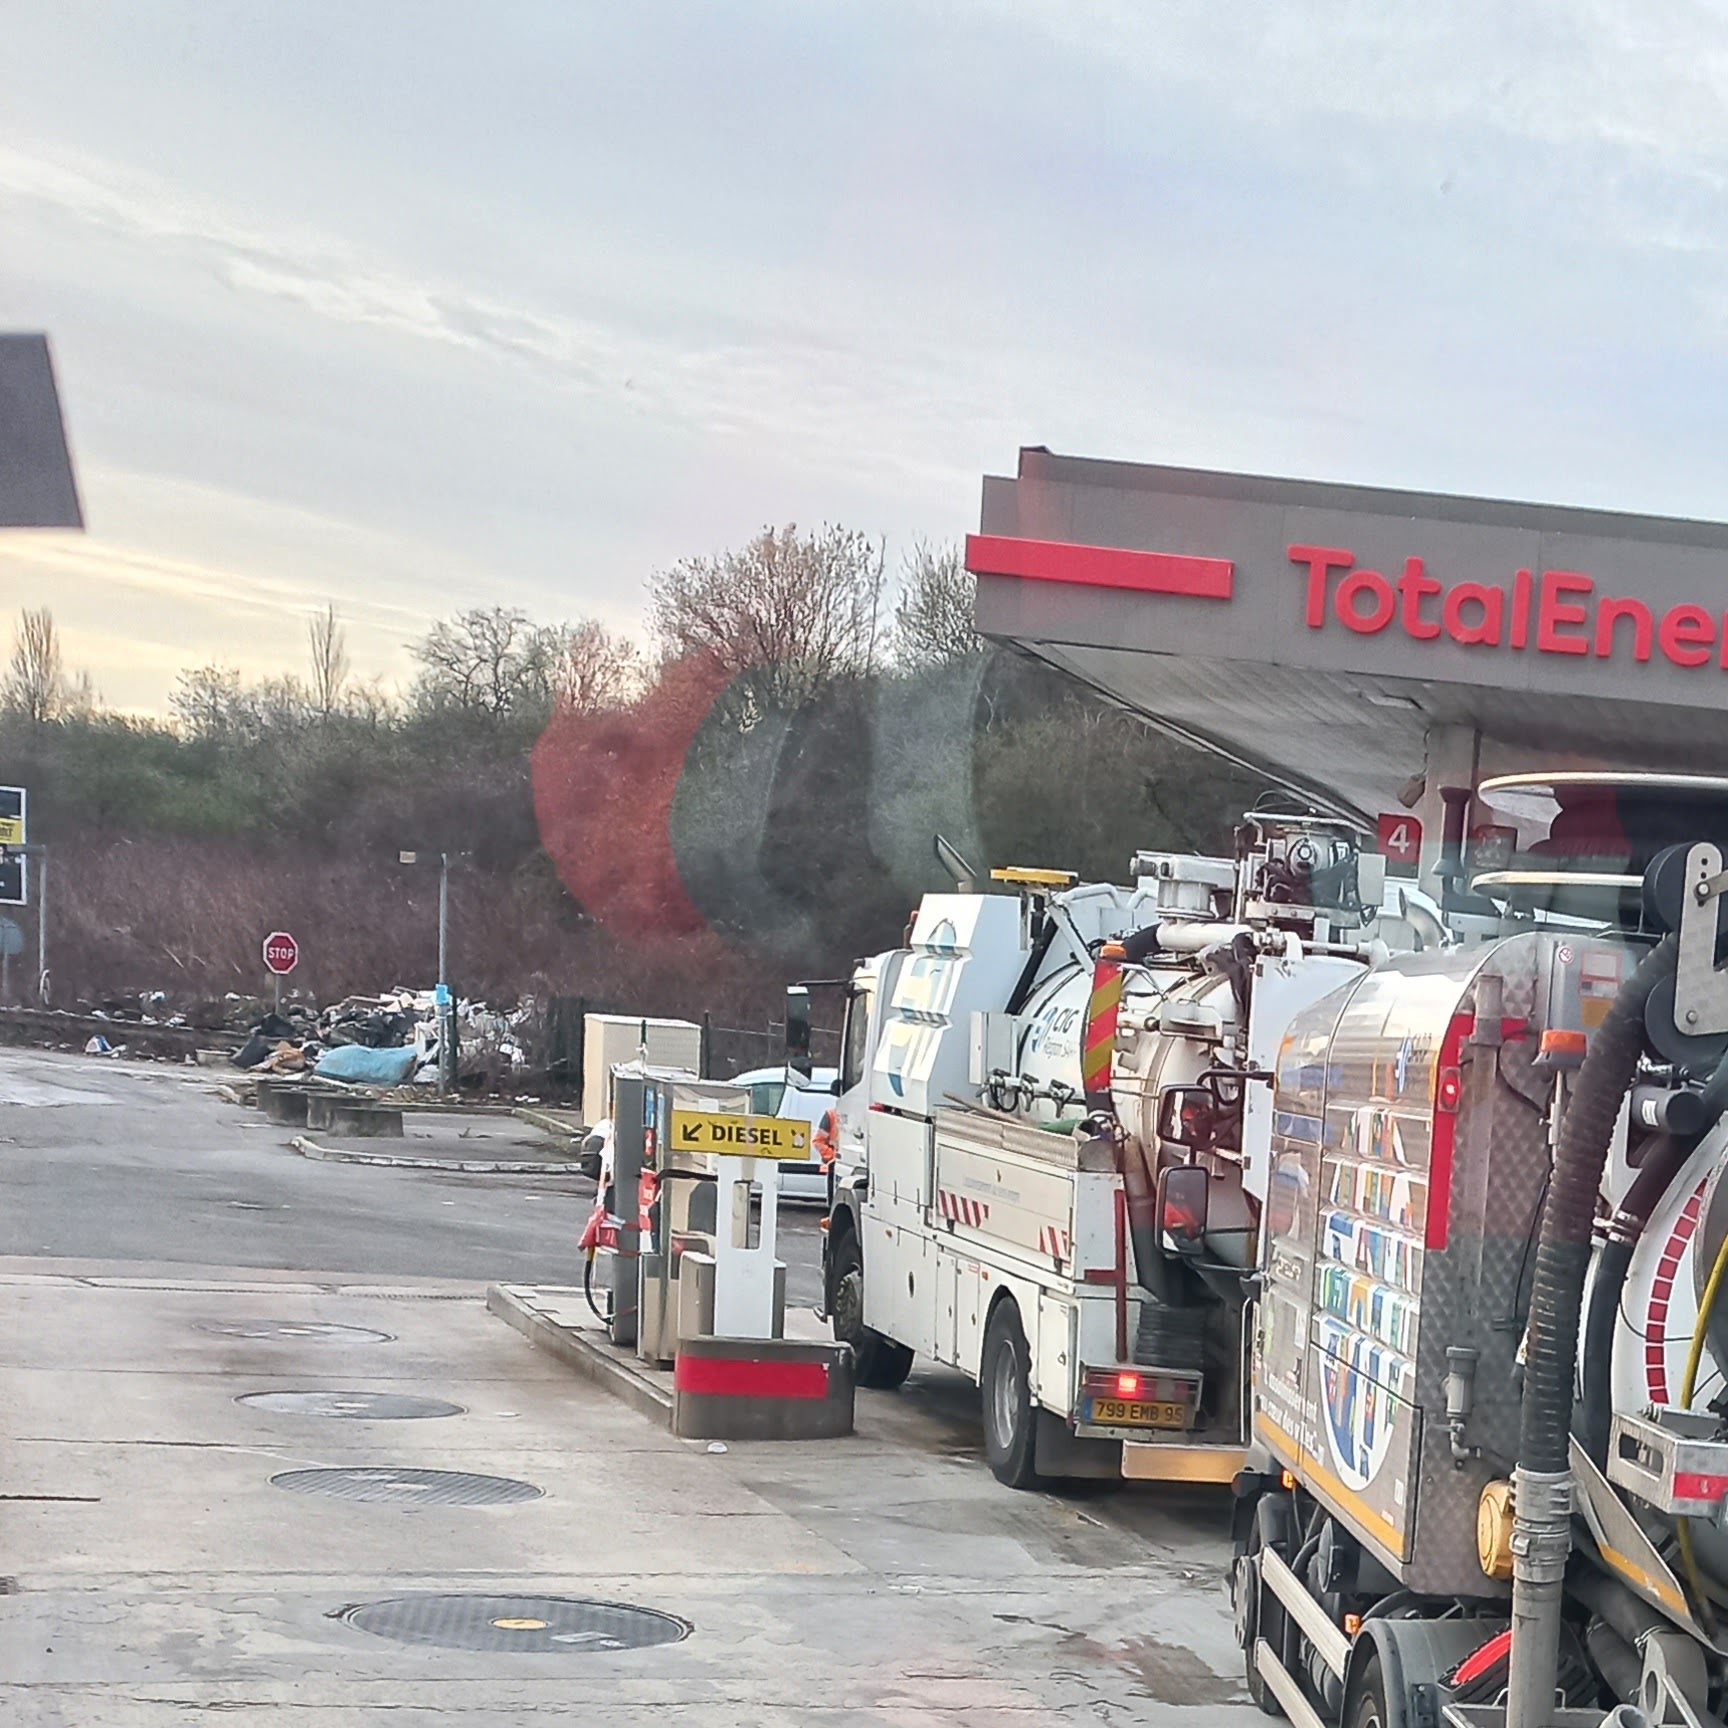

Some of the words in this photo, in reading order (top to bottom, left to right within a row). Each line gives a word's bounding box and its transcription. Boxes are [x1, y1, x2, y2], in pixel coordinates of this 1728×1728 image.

[1387, 824, 1410, 854] 4
[268, 947, 294, 960] STOP
[711, 1125, 782, 1146] DIESEL
[1096, 1401, 1126, 1418] 799
[1130, 1404, 1159, 1420] EMB
